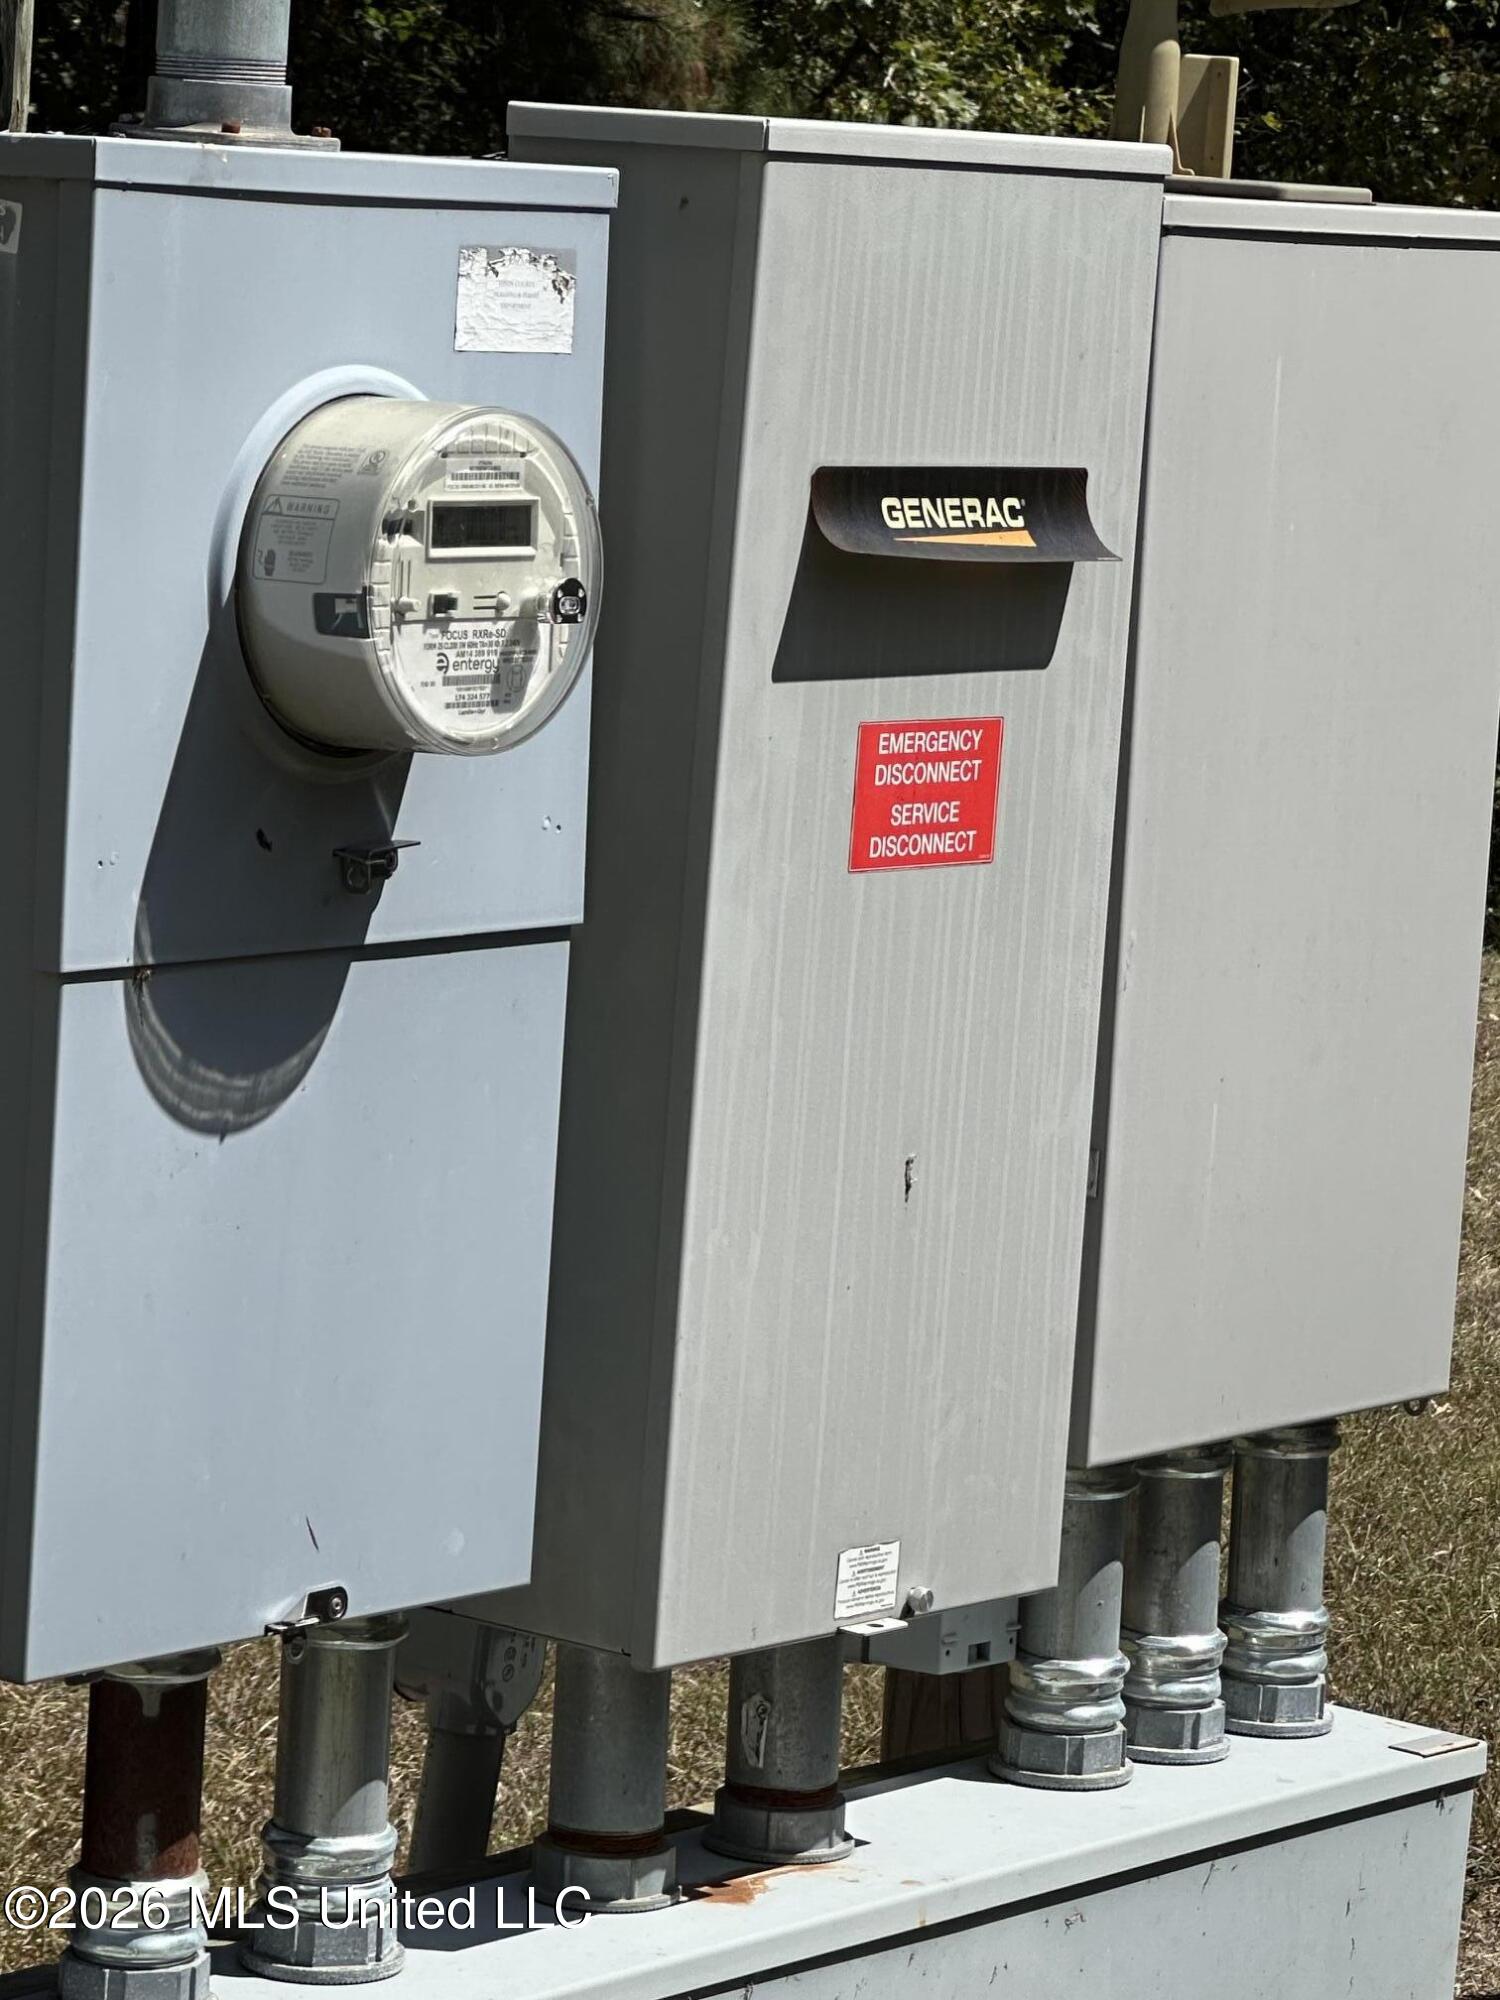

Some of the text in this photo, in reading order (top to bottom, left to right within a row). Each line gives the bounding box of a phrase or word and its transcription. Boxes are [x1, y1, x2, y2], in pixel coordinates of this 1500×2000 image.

[286, 501, 330, 515] WARNING
[881, 497, 1025, 529] GENERAC
[441, 630, 469, 640] FOCUS
[452, 658, 500, 674] entergy
[878, 729, 983, 755] EMERGENCY
[874, 759, 982, 786] DISCONNECT
[890, 801, 960, 826] SERVICE
[869, 830, 977, 858] DISCONNECT
